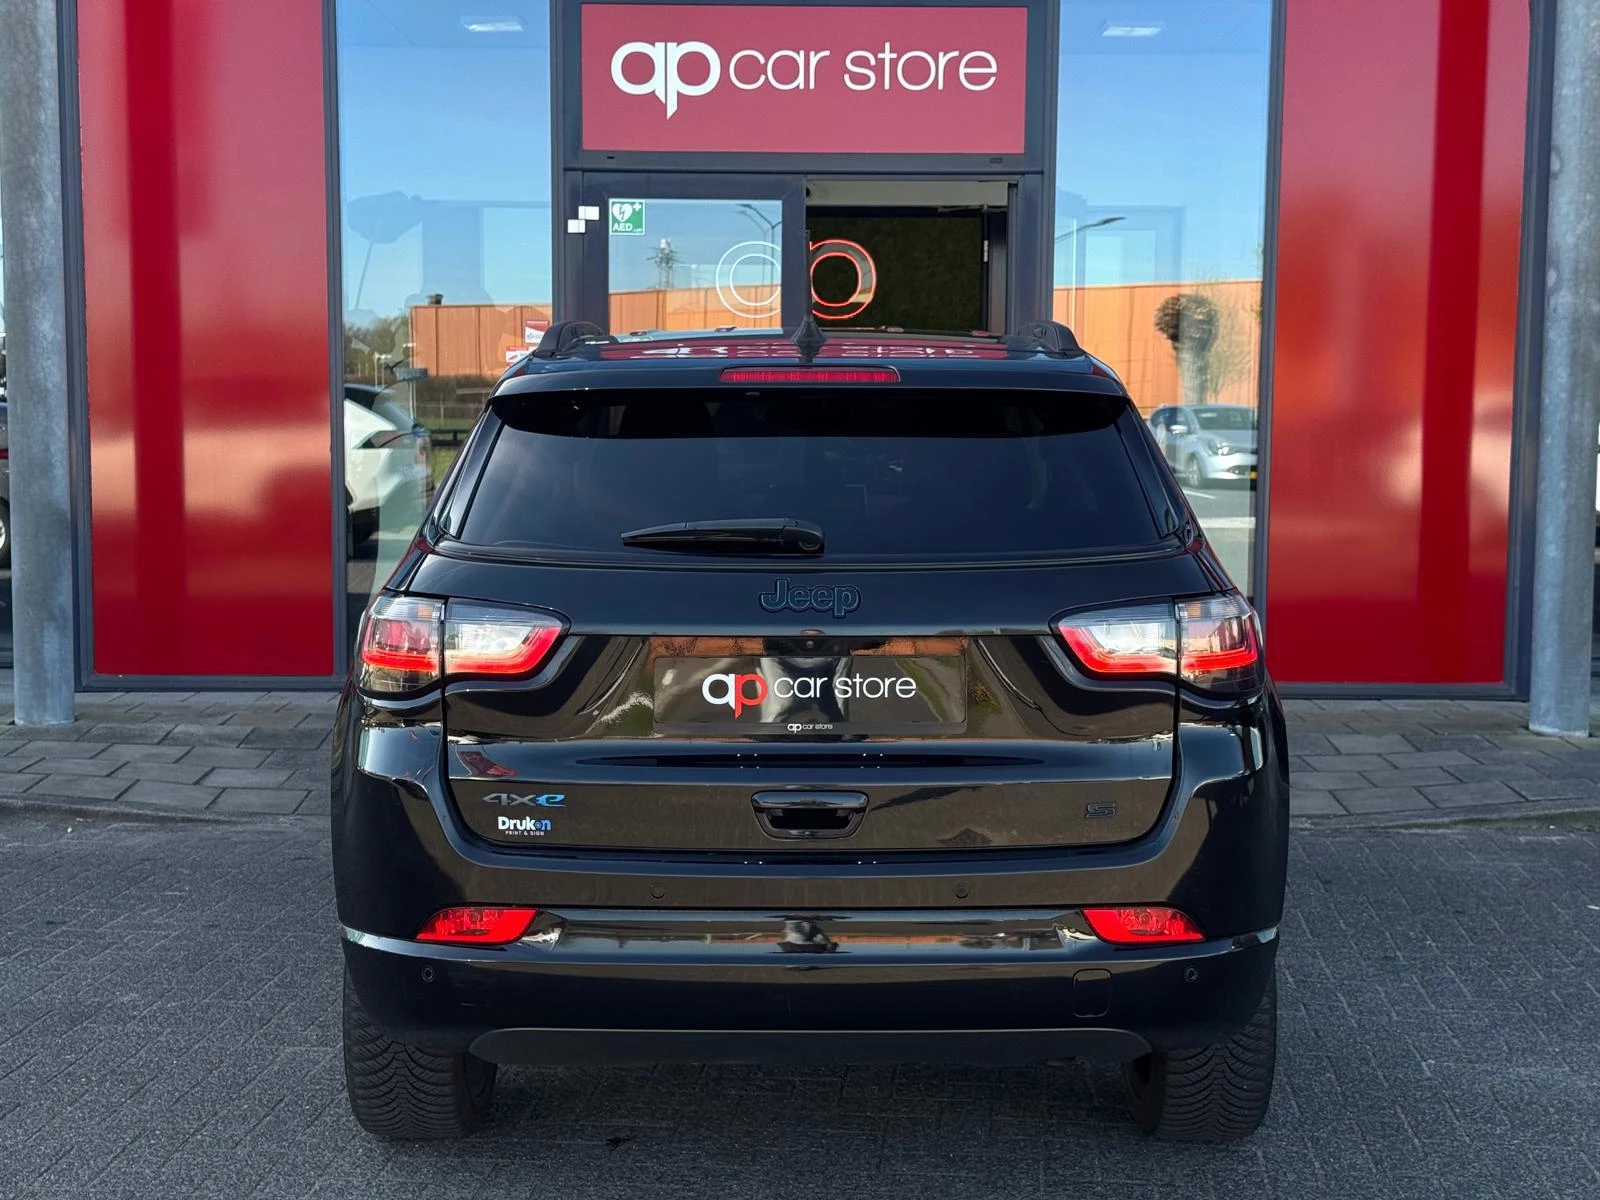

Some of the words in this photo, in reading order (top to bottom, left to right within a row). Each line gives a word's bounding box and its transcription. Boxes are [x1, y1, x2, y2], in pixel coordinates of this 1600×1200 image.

[728, 49, 831, 90] car
[843, 42, 998, 91] store
[612, 223, 633, 232] AED
[758, 577, 861, 618] Jeep
[774, 676, 828, 698] car
[834, 673, 917, 699] store
[1085, 802, 1116, 818] S
[498, 816, 551, 831] Drukon
